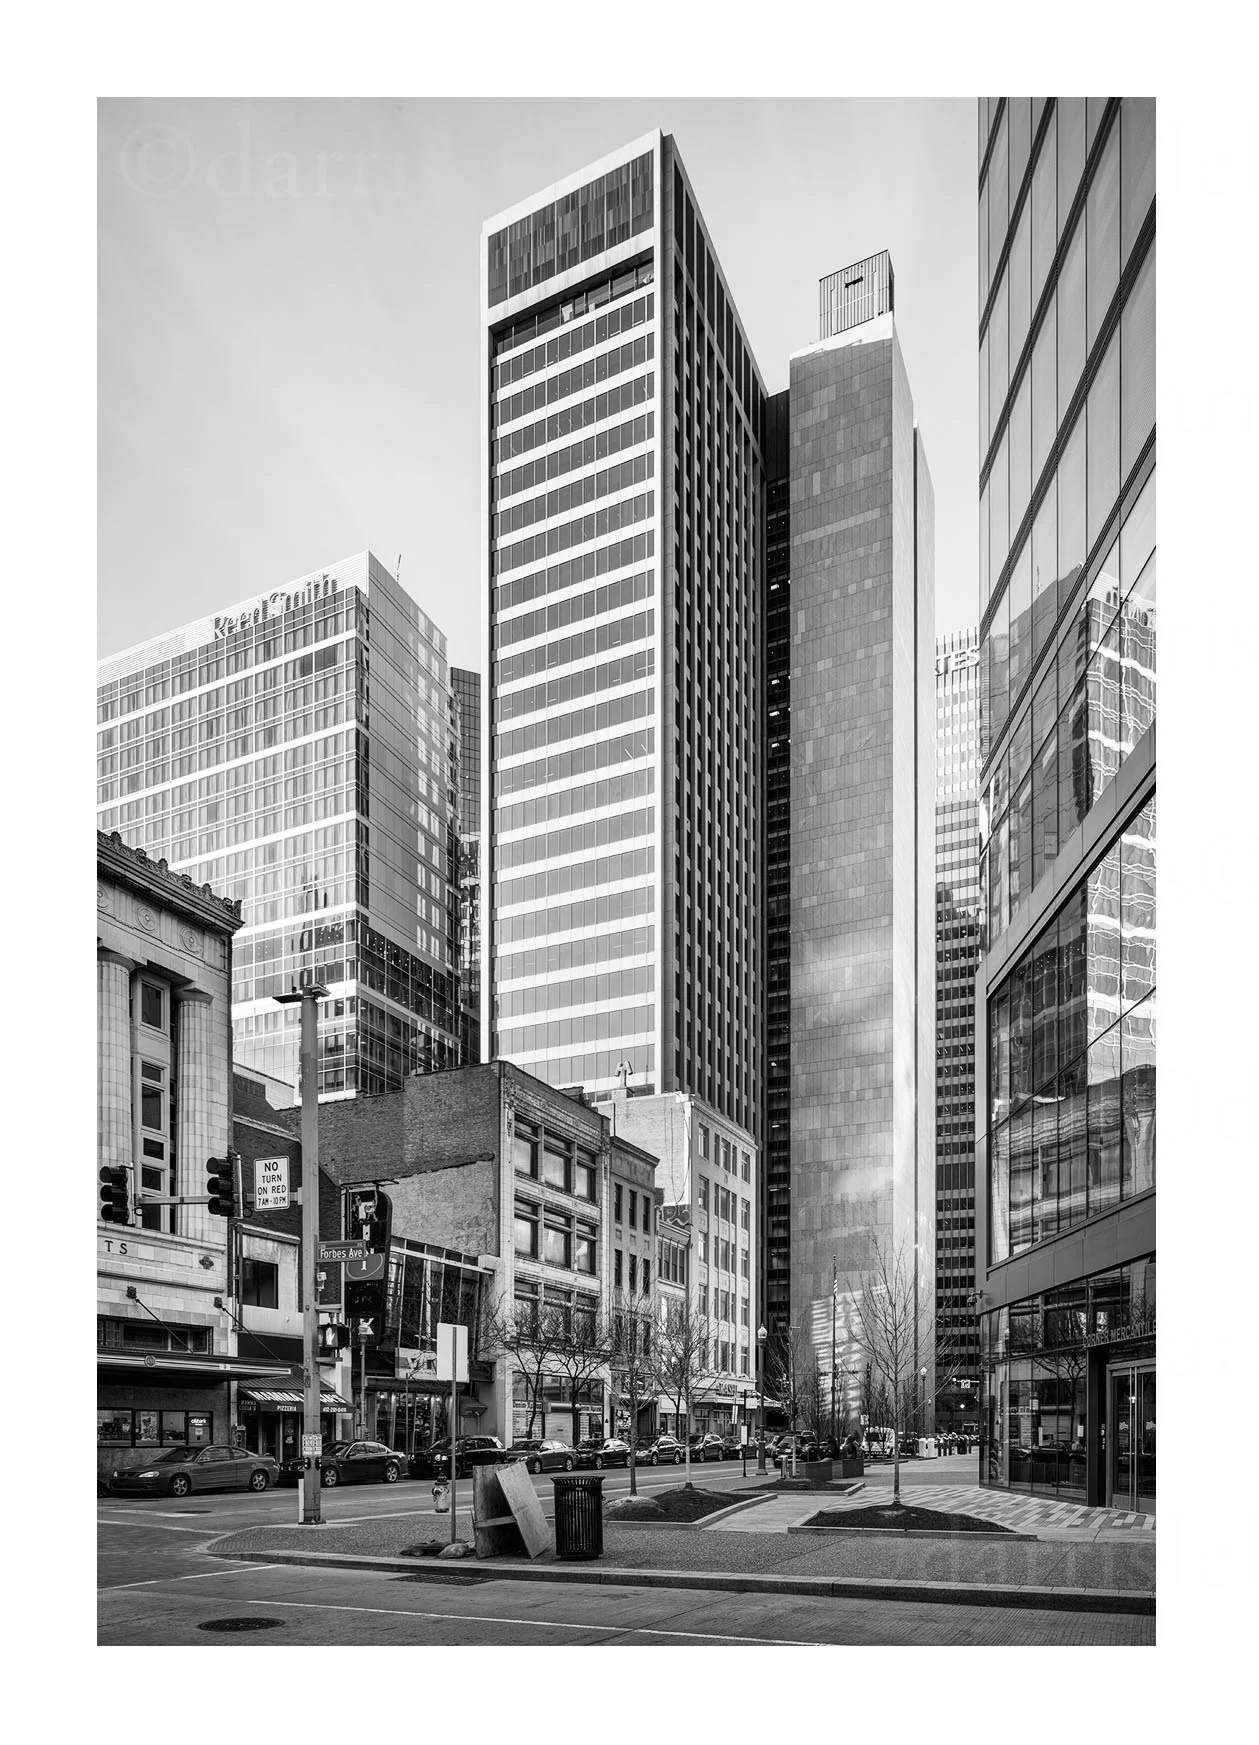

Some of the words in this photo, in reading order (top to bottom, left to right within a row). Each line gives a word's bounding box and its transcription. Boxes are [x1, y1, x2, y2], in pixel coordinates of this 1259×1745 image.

[935, 647, 981, 676] TES
[264, 1161, 278, 1172] NO
[261, 1174, 282, 1184] TURN
[257, 1186, 268, 1196] ON
[271, 1184, 287, 1194] RED
[320, 1248, 347, 1260] Forbes
[348, 1247, 363, 1259] Ave
